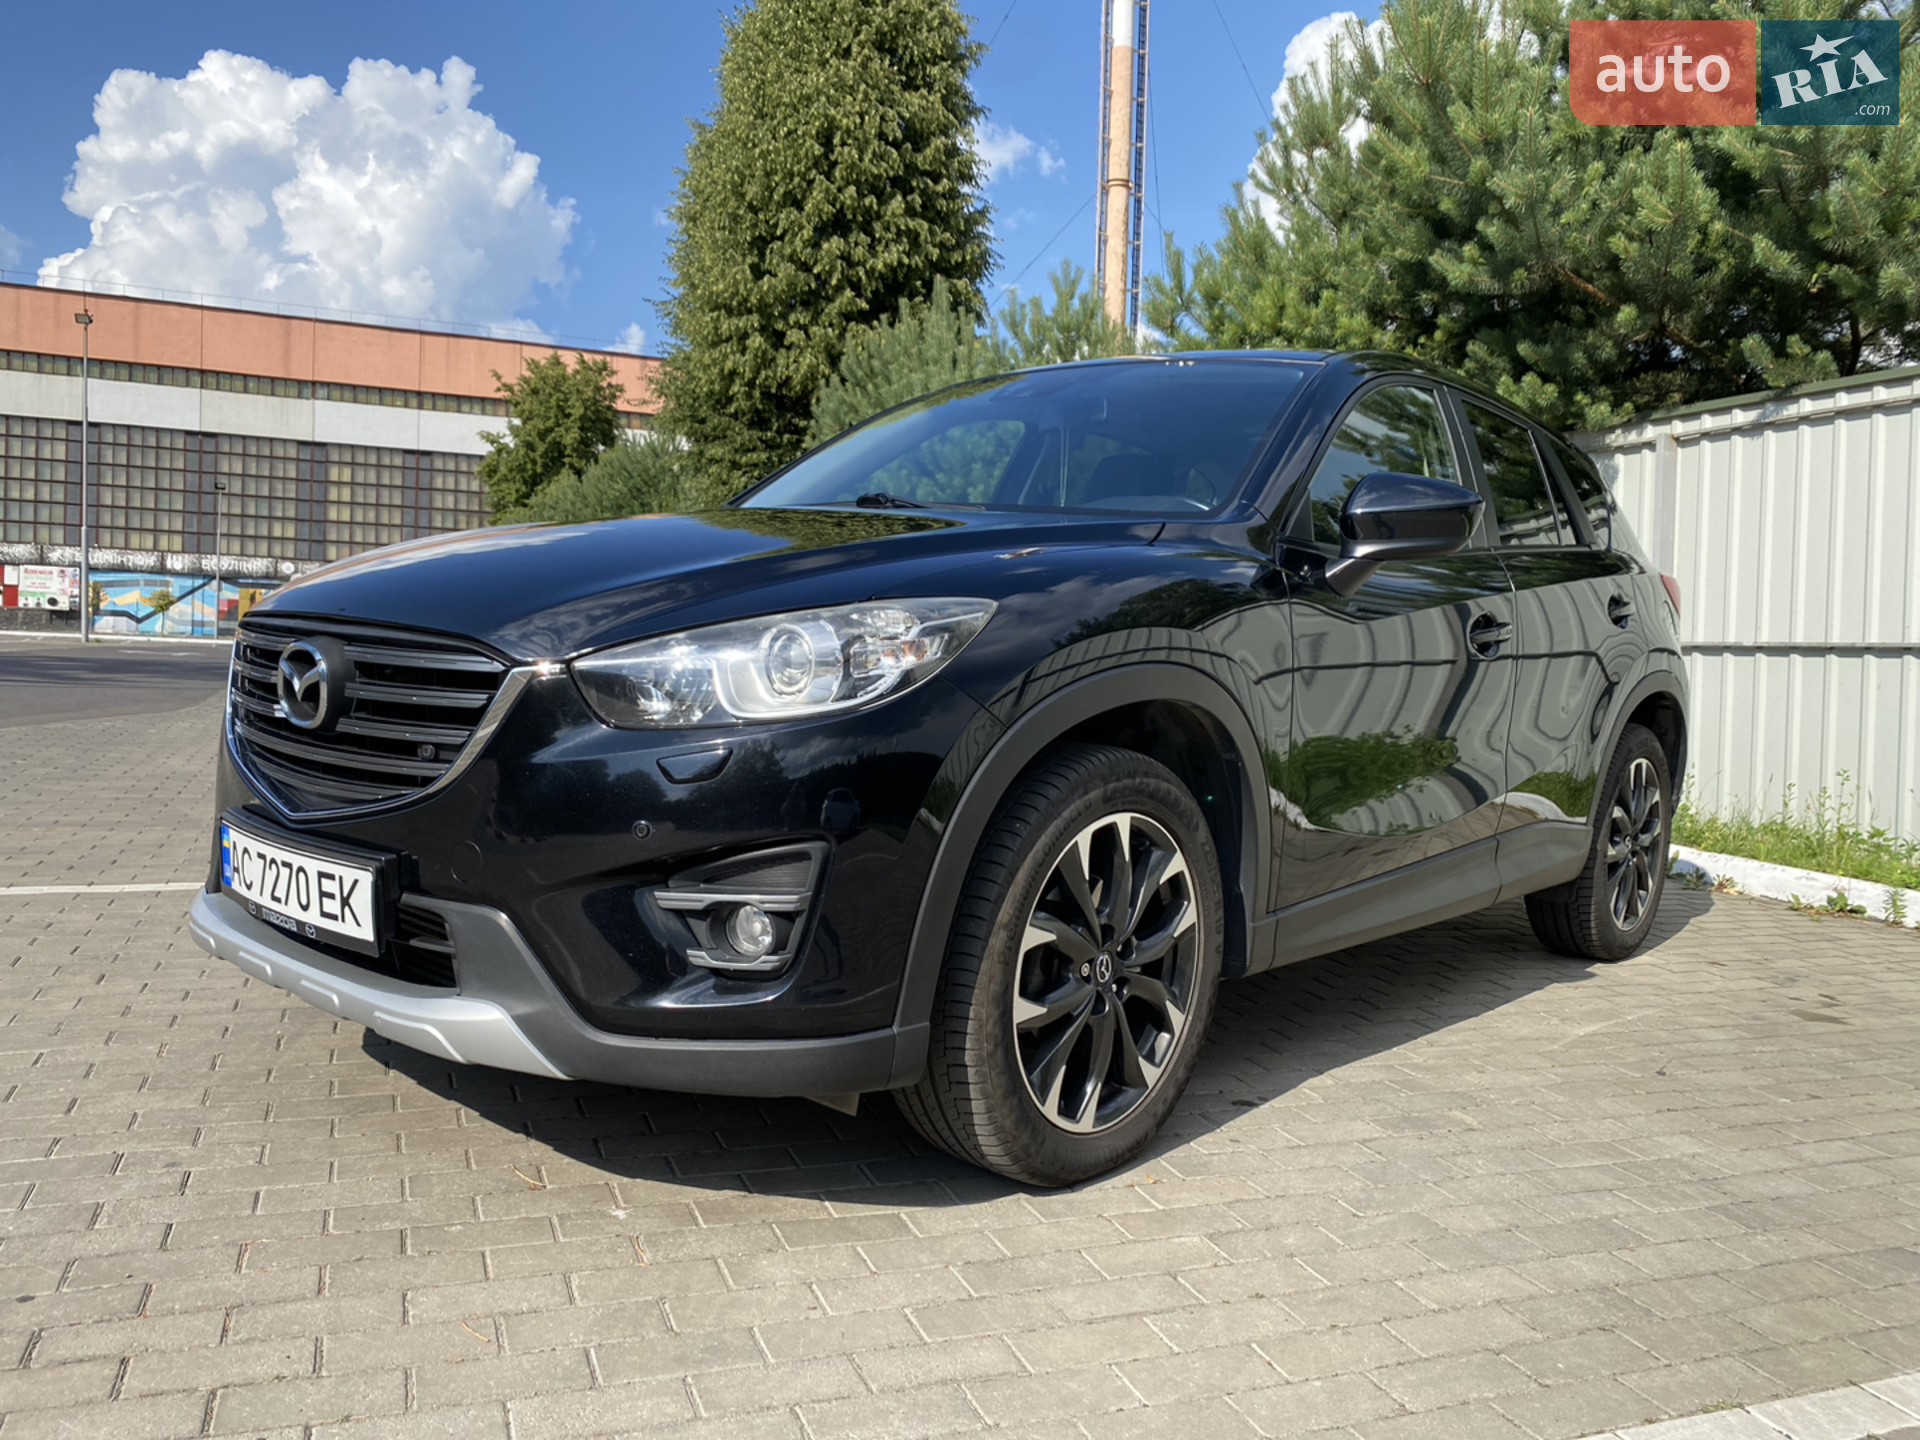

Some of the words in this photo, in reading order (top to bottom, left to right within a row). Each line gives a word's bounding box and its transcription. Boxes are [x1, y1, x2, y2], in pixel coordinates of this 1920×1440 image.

[232, 840, 253, 892] AC
[257, 851, 310, 913] 7270
[317, 870, 362, 928] EK
